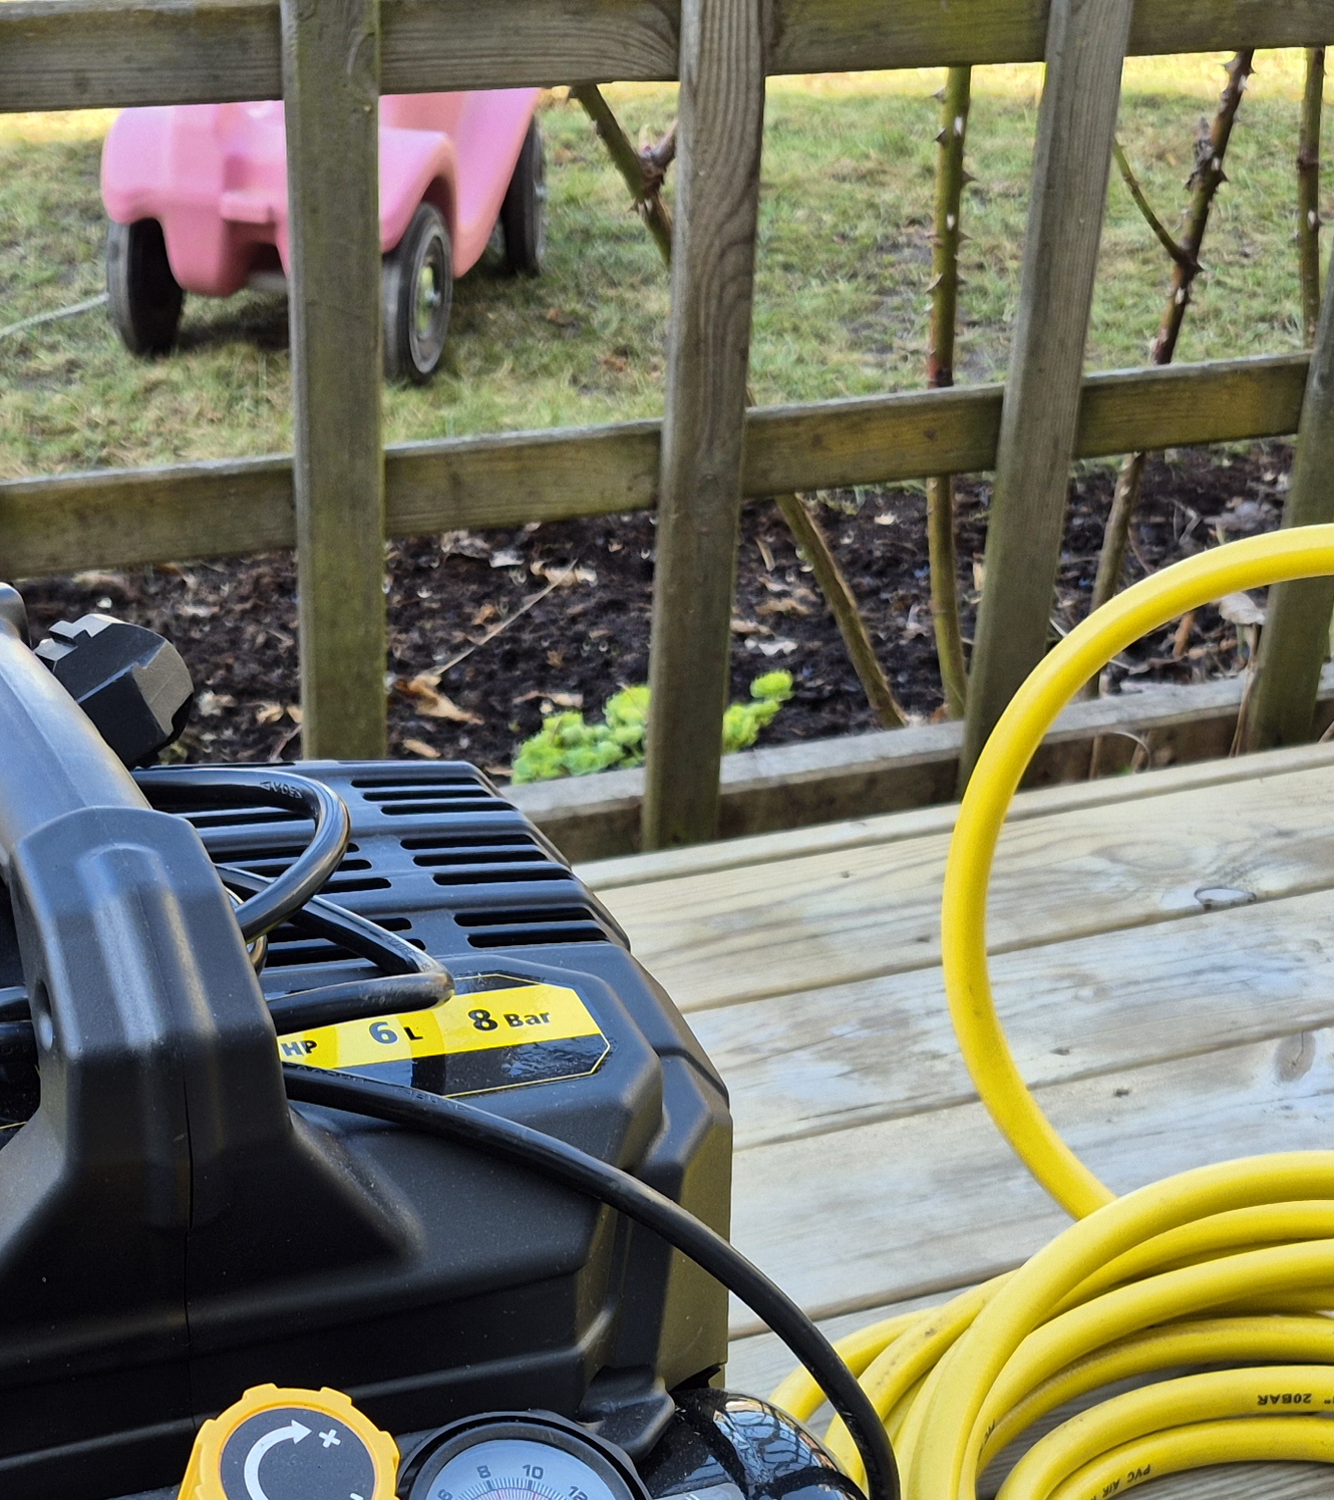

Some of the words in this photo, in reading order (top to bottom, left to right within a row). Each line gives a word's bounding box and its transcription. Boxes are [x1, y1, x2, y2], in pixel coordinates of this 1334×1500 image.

[281, 1040, 317, 1057] HP
[369, 1021, 397, 1044] 6
[404, 1026, 423, 1041] L
[469, 1009, 498, 1031] 8
[503, 1011, 551, 1029] Bar
[1257, 1393, 1312, 1405] 20BAR
[476, 1465, 491, 1479] 8
[522, 1464, 544, 1480] 10
[1127, 1464, 1151, 1483] PVC
[1102, 1478, 1120, 1498] AIR
